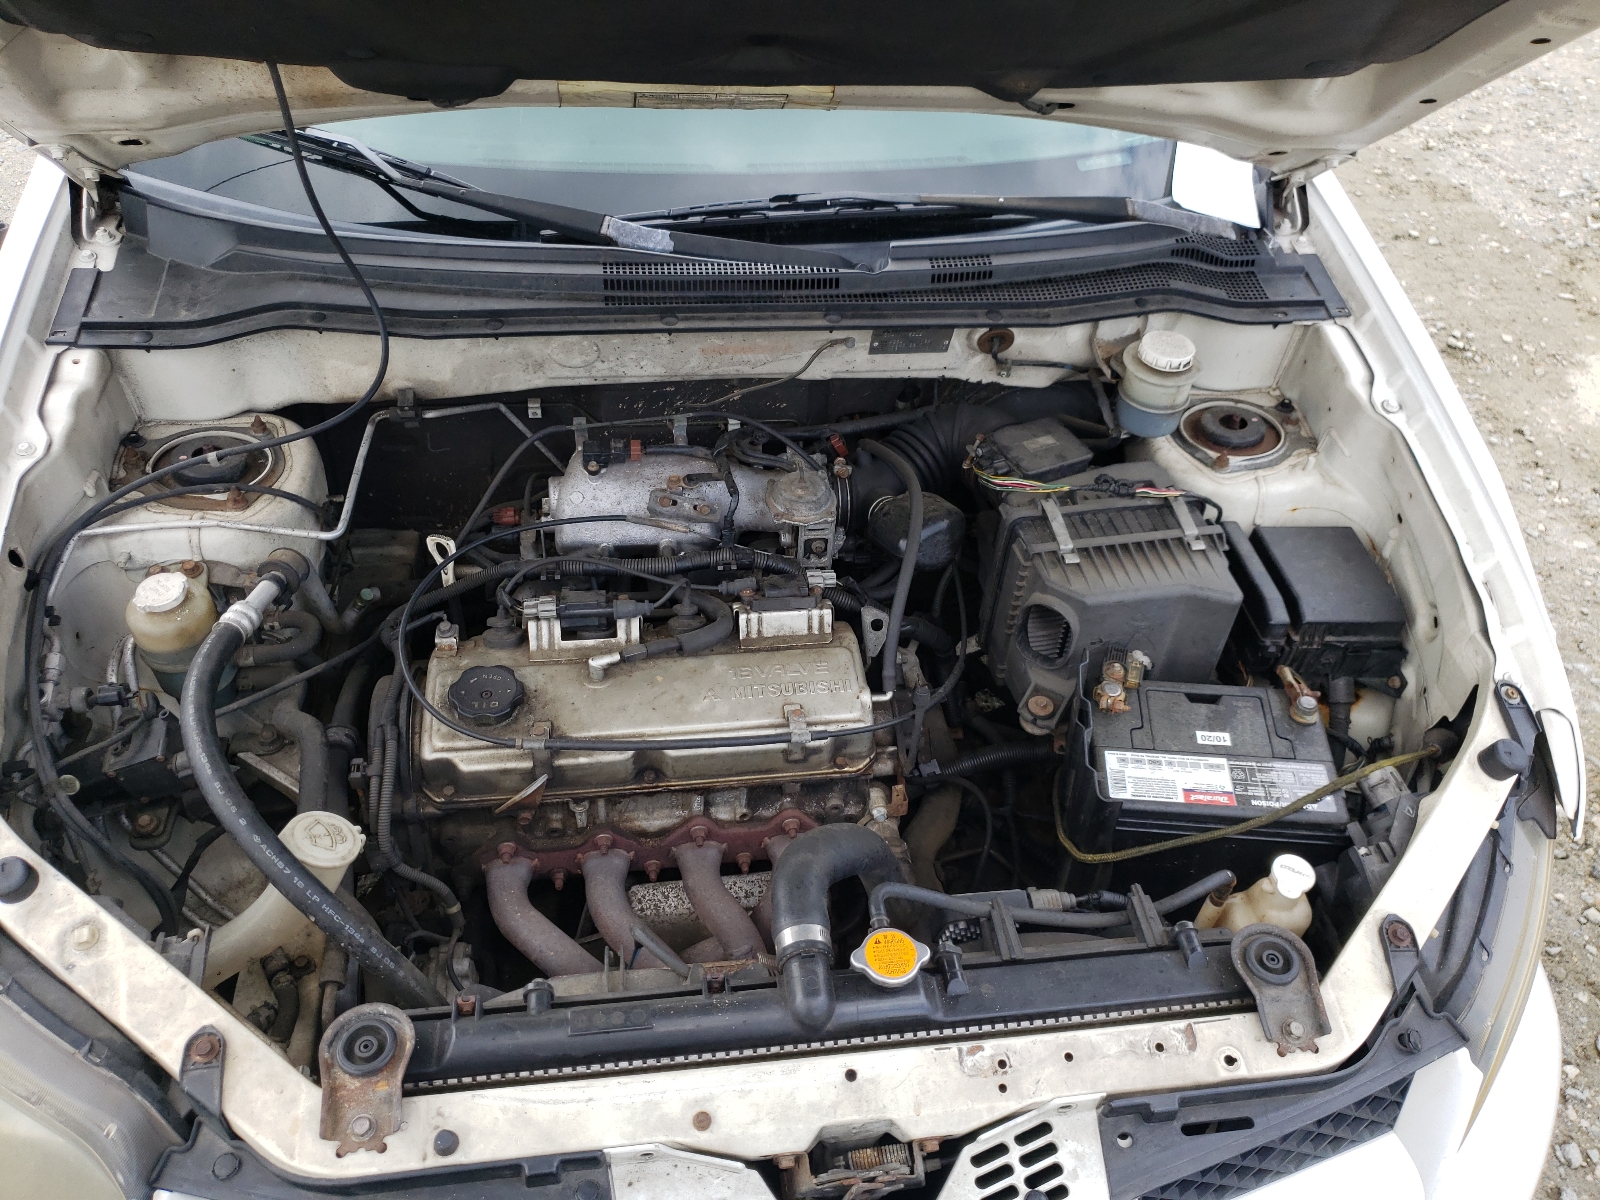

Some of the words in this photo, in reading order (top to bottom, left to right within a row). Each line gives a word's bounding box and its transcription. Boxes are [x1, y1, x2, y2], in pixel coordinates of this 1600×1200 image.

[482, 673, 502, 681] OPEN
[730, 679, 852, 700] MITSUBISHI
[471, 701, 499, 709] OIL
[1201, 734, 1228, 743] 10/20
[1189, 793, 1230, 804] Duralast
[306, 889, 320, 902] LP
[321, 903, 365, 944] HFC-134a
